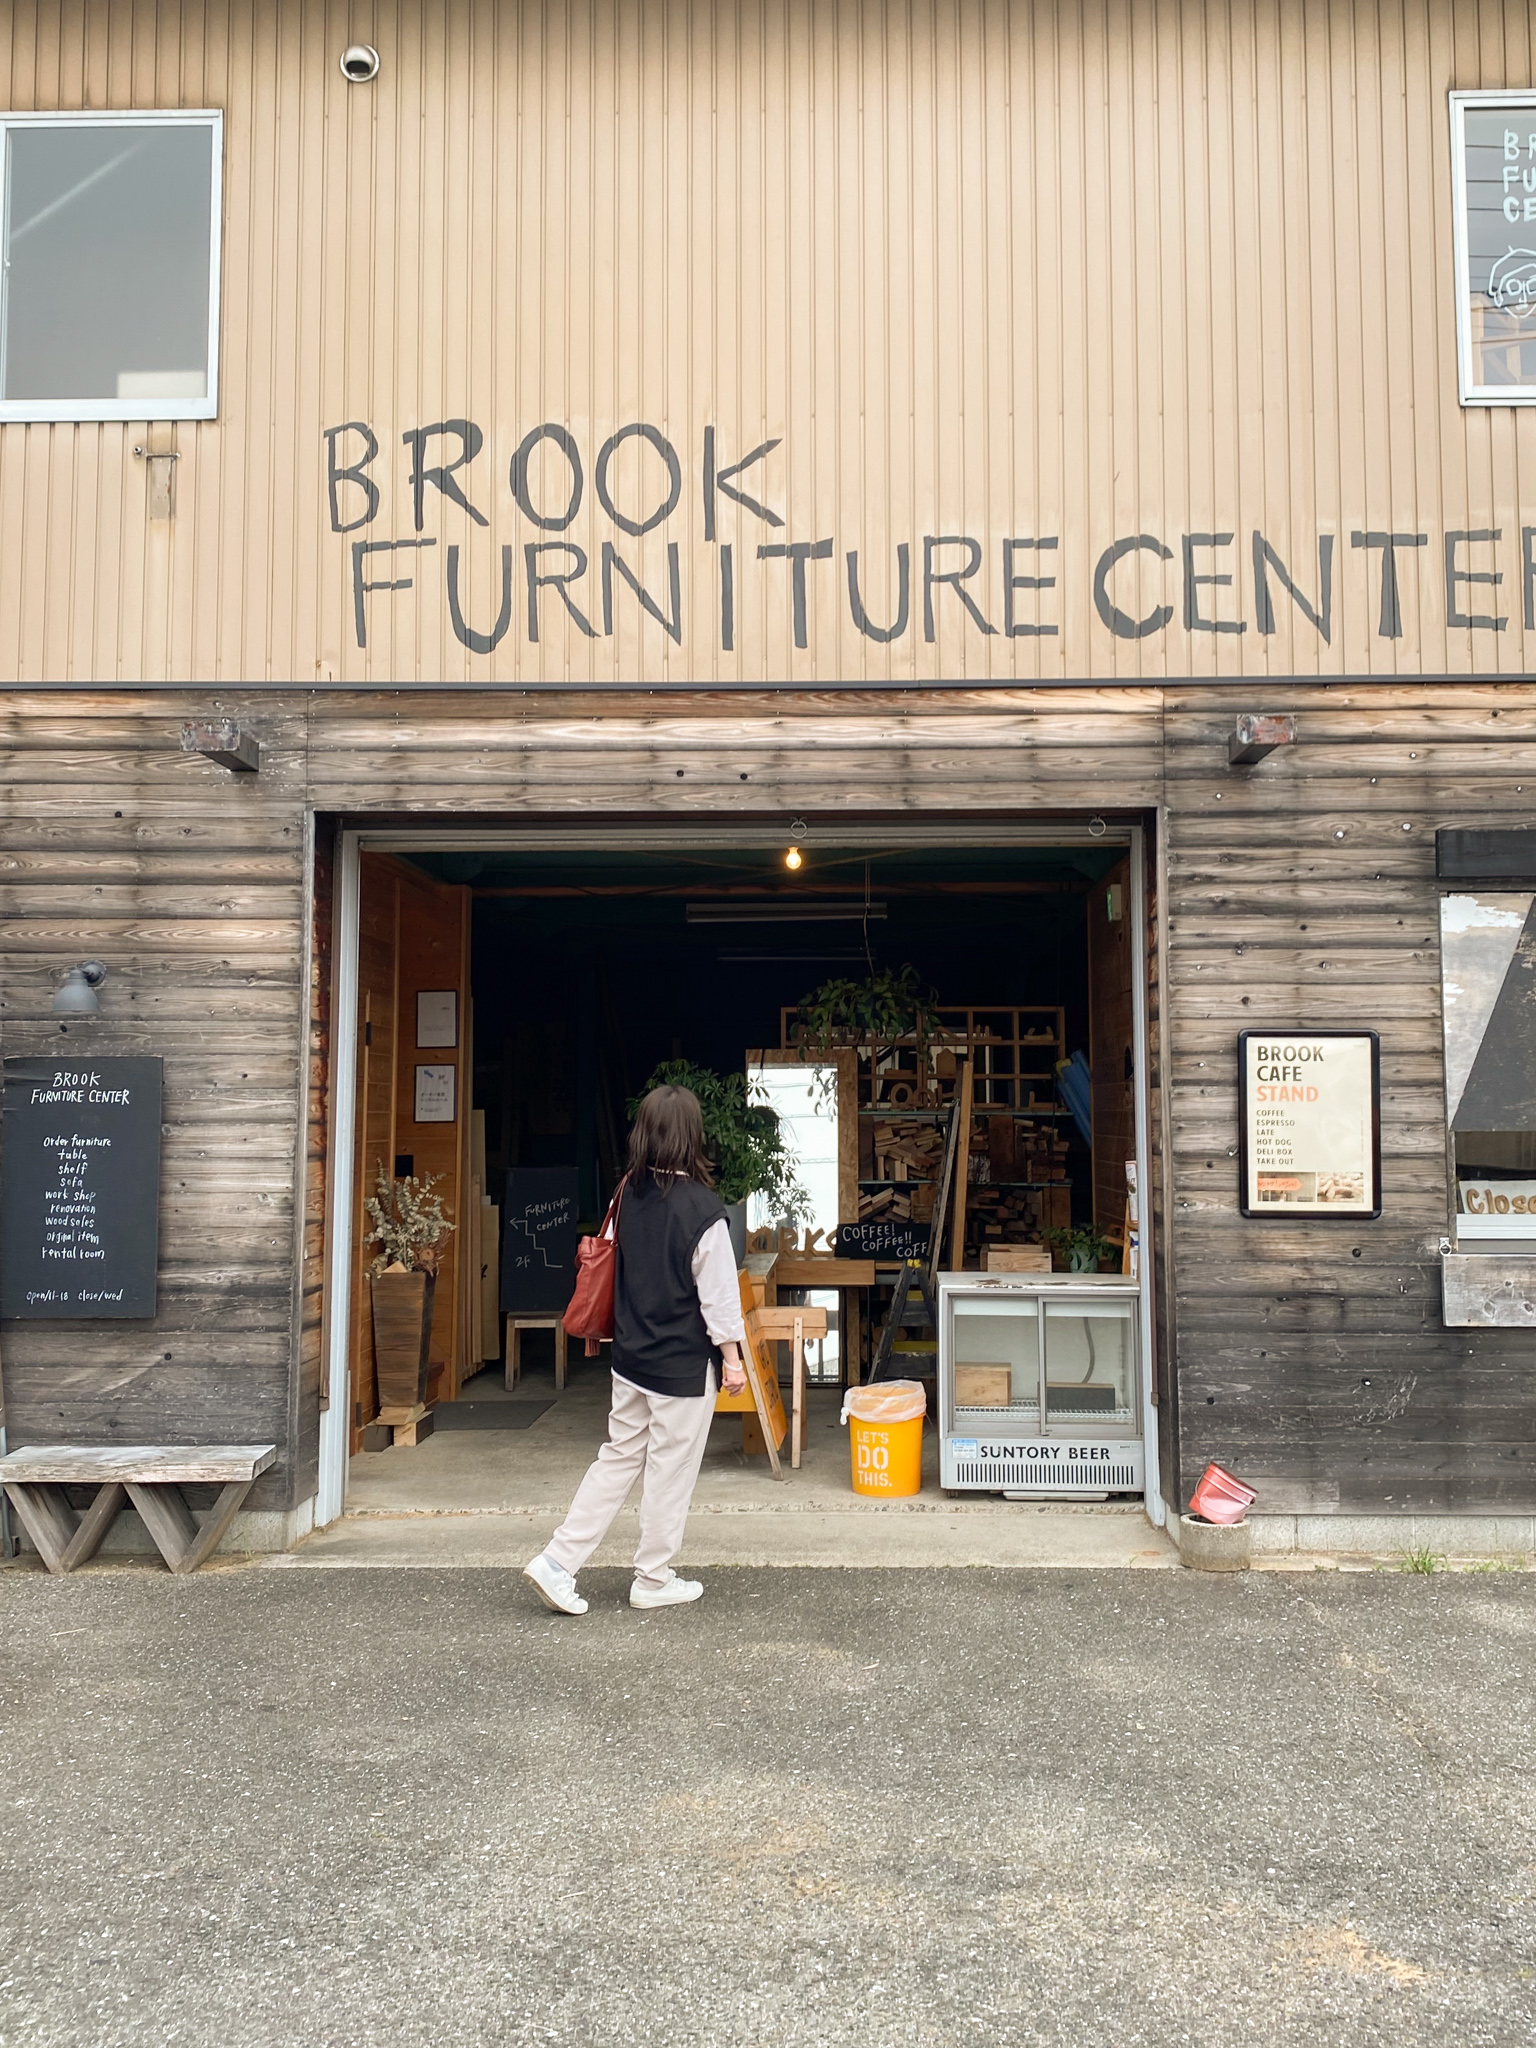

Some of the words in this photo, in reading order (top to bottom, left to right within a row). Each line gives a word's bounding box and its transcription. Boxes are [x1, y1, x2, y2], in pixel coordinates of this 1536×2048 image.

[323, 418, 786, 542] BROOK
[351, 535, 1058, 655] FURNITURE
[1092, 527, 1536, 647] CENTE
[1257, 1045, 1324, 1062] BROOK
[52, 1071, 101, 1087] BROOK
[1256, 1065, 1302, 1082] CAFE
[30, 1088, 85, 1104] FURNITURE
[88, 1088, 130, 1106] CENTER
[1256, 1085, 1319, 1102] STAND
[1256, 1109, 1285, 1117] COFFEE
[1256, 1119, 1295, 1127] ESPRESSO
[43, 1135, 69, 1147] Order
[71, 1133, 112, 1147] furniture
[1256, 1138, 1272, 1146] HOT
[1275, 1138, 1292, 1146] DOG
[57, 1148, 88, 1160] table
[1256, 1148, 1274, 1156] DELI
[1276, 1148, 1293, 1156] BOX
[57, 1161, 88, 1175] shelf
[59, 1176, 83, 1188] sofa
[45, 1188, 69, 1200] work
[73, 1189, 96, 1203] shop
[50, 1203, 96, 1214] renovation
[525, 1197, 571, 1217] FURNITURE
[70, 1214, 95, 1228] sales
[536, 1212, 570, 1231] CENTER
[77, 1230, 100, 1245] item
[842, 1223, 895, 1242] COFFEE!
[861, 1231, 912, 1252] COFFEE!!
[41, 1245, 77, 1259] rental
[79, 1248, 105, 1260] room
[515, 1254, 531, 1268] 2F
[26, 1289, 69, 1305] open/11-18
[78, 1288, 124, 1302] close/wed
[856, 1430, 889, 1445] LET'S
[857, 1445, 889, 1471] DO
[980, 1445, 1061, 1460] SUNTORY
[1068, 1447, 1111, 1461] BEER
[857, 1470, 893, 1488] THIS.
